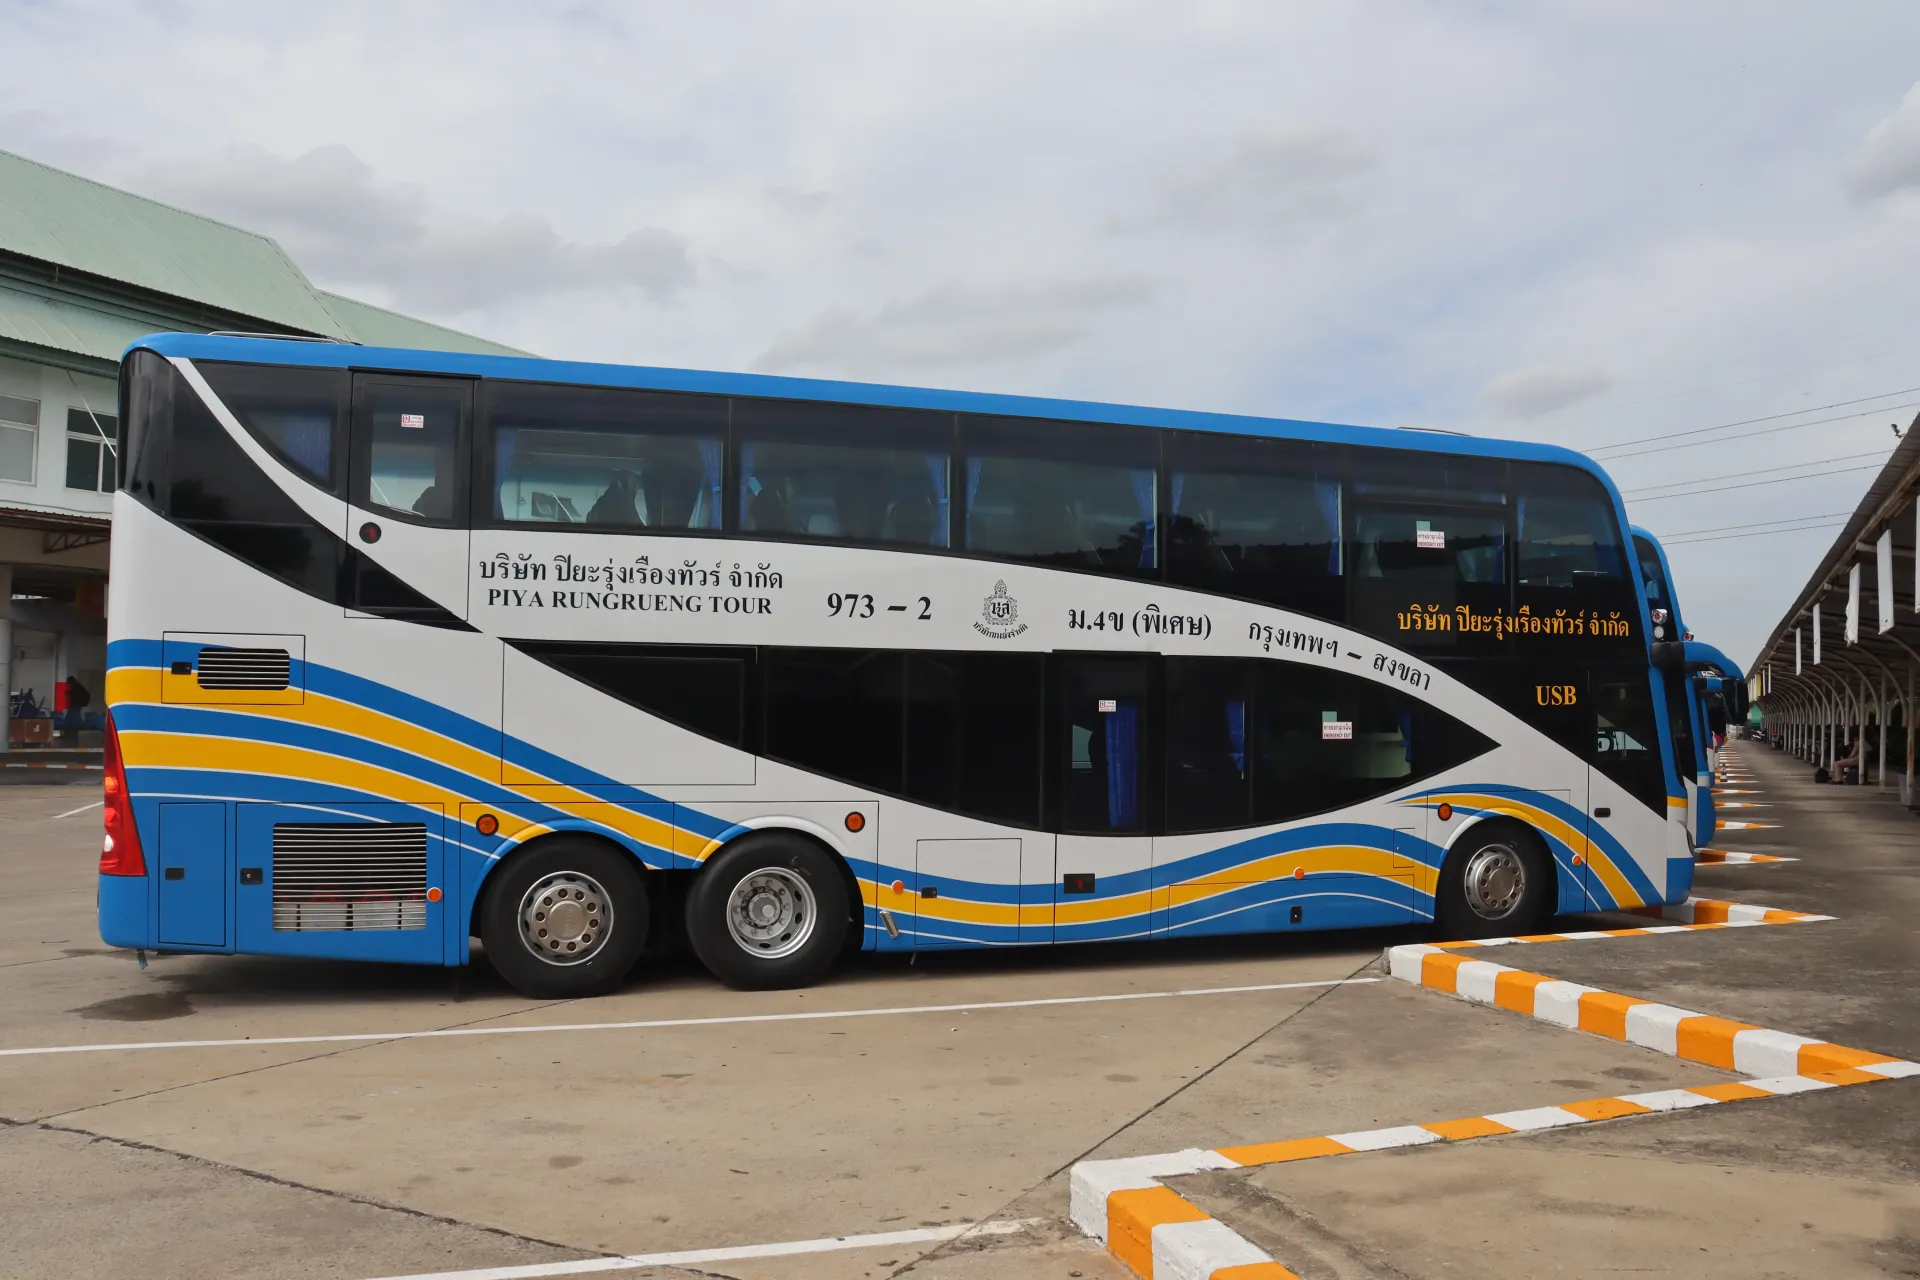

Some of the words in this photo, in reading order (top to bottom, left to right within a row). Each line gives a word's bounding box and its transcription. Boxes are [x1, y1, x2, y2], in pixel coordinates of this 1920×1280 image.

[479, 552, 546, 581] บริษัท
[554, 554, 722, 591] ปิยะรุ่งเรืองทัวร์
[728, 562, 783, 589] จำกัด
[488, 588, 544, 607] PIYA
[552, 592, 702, 613] RUNGRUENG
[708, 596, 772, 615] TOUR
[827, 592, 875, 619] 973
[917, 596, 932, 621] 2
[1068, 608, 1124, 632] ม.4ข
[1132, 604, 1212, 640] (พิเศษ)
[1397, 603, 1451, 631] บริษัท
[1455, 604, 1584, 641] ปิยะรุ่งเรืองทัวร์
[1589, 611, 1629, 637] จำกัด
[1249, 622, 1338, 652] กรุงเทพฯ
[1373, 653, 1430, 690] สงขลา
[1535, 685, 1577, 706] USB
